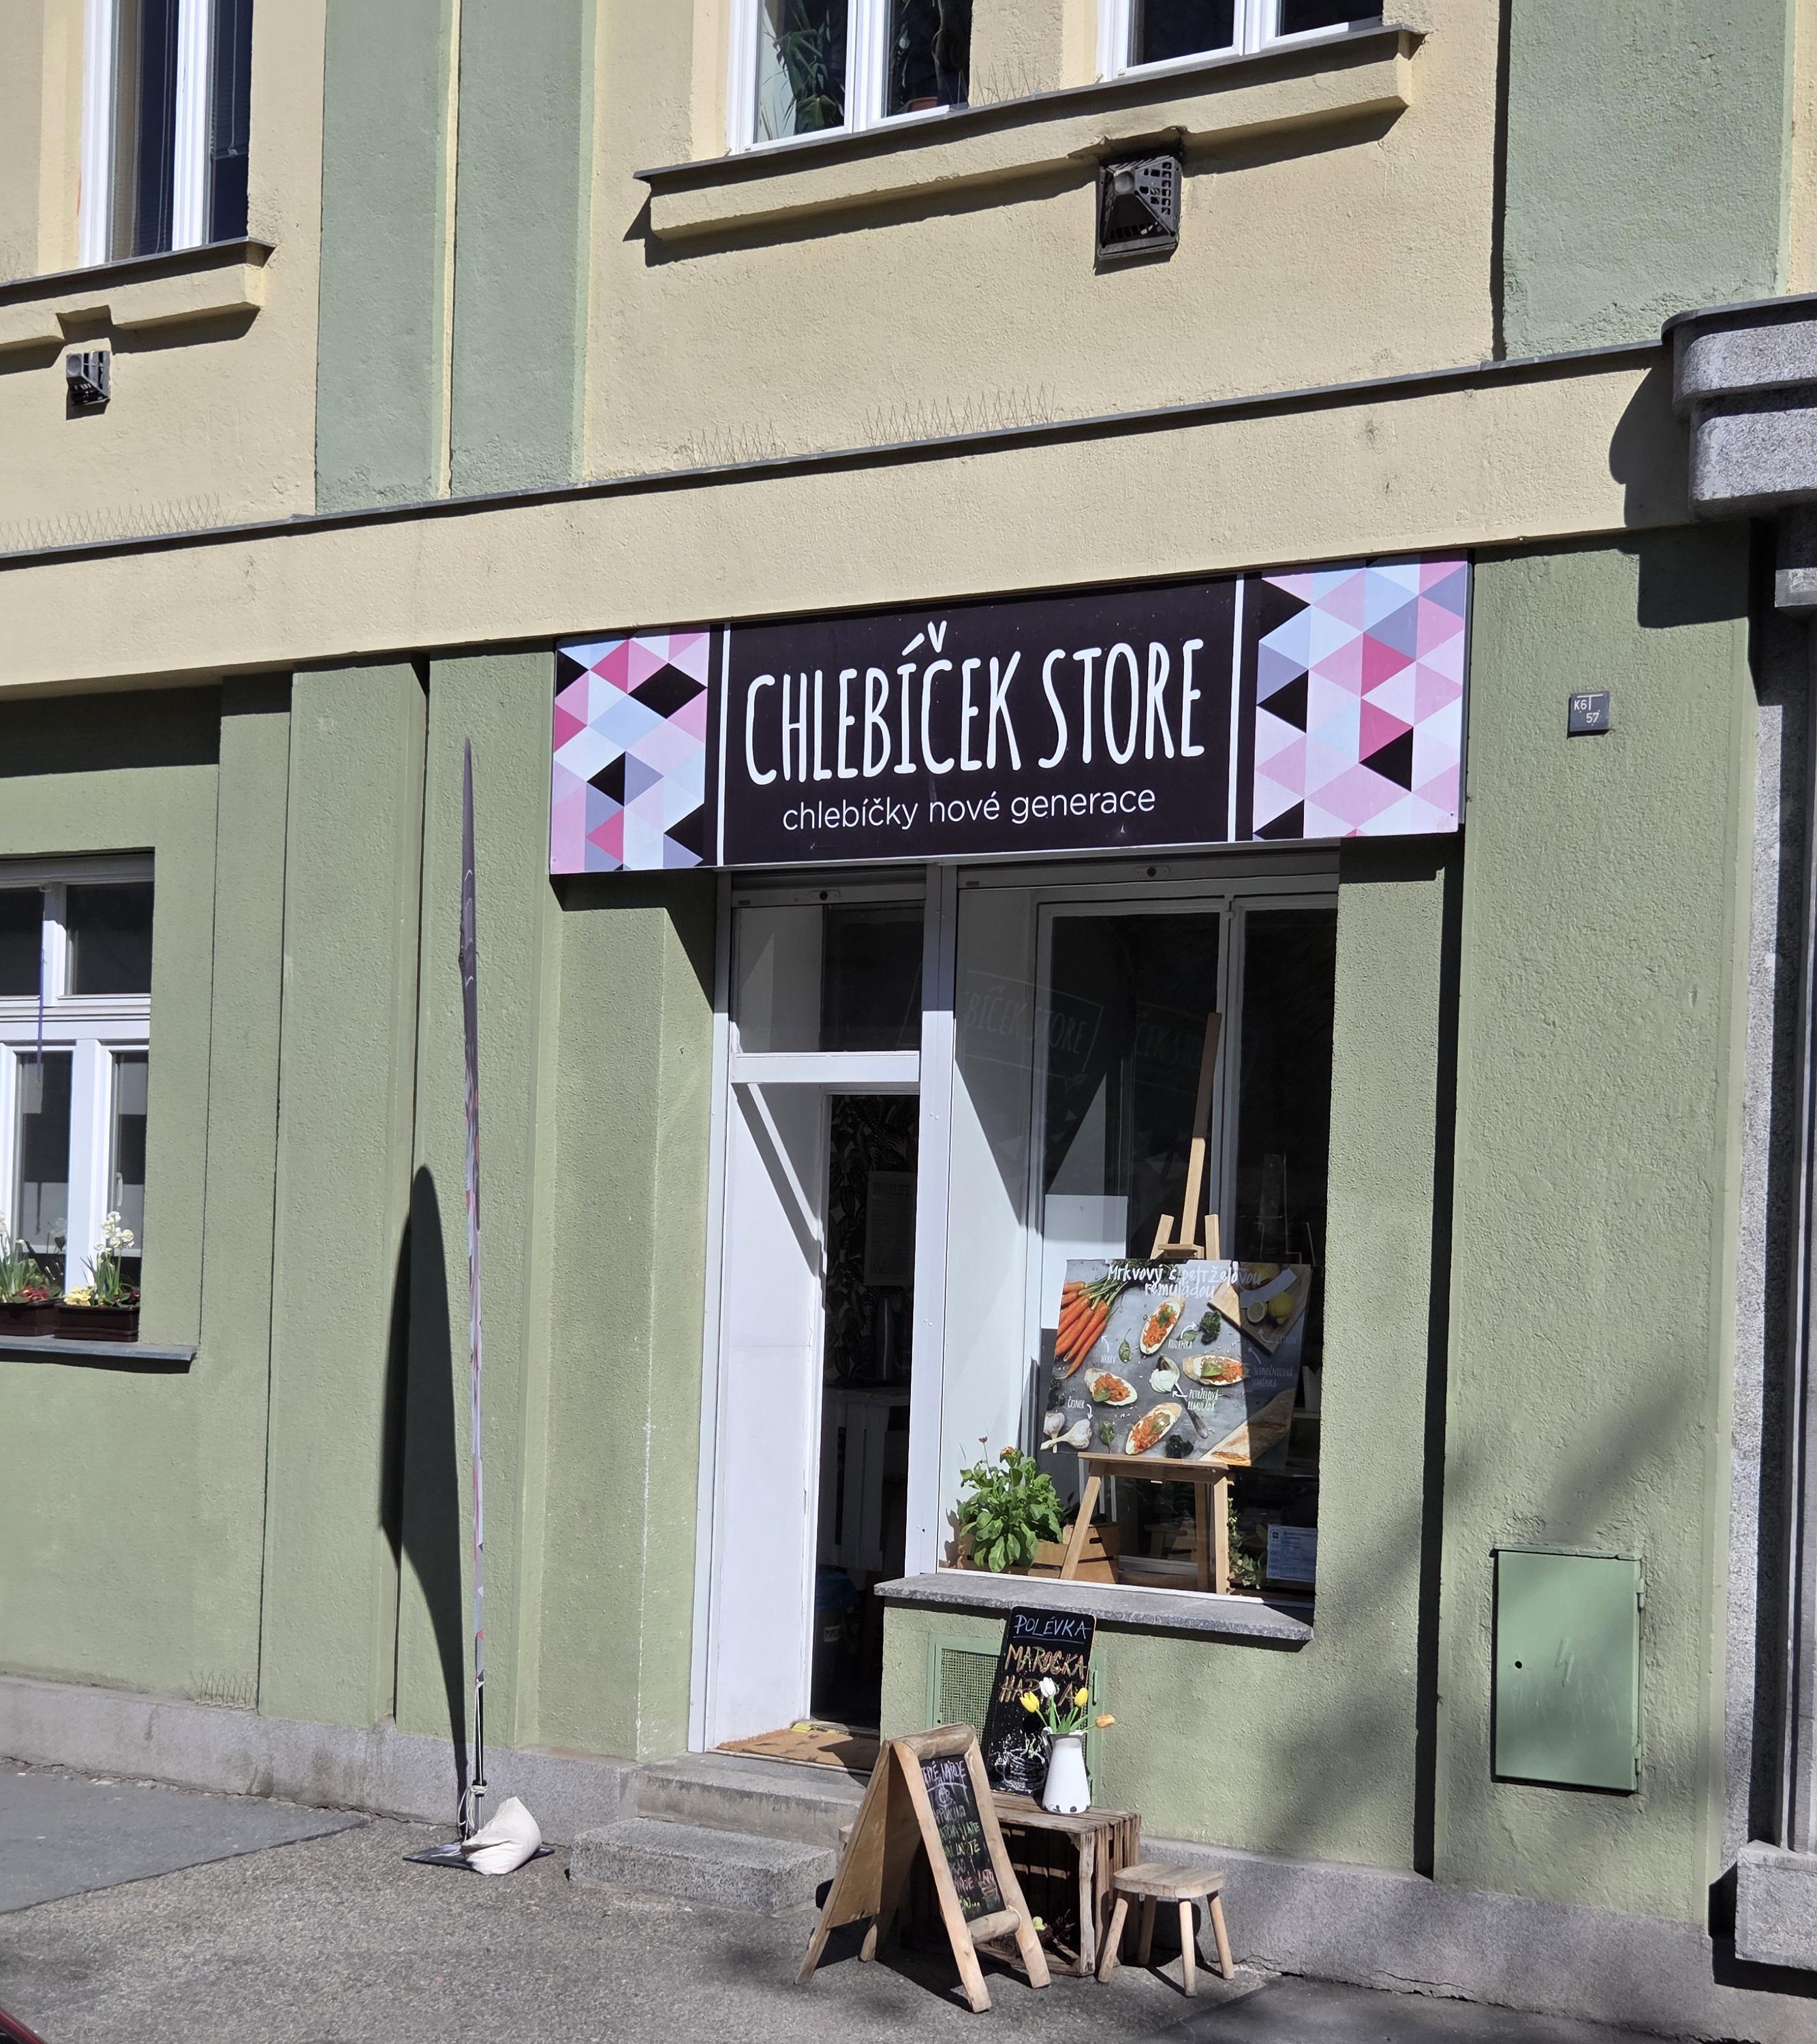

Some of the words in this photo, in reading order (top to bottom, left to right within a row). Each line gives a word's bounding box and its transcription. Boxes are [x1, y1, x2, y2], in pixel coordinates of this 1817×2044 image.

[745, 620, 1021, 786] CHLEBÍČEK
[1038, 638, 1205, 769] STORE
[1586, 712, 1600, 723] 57
[782, 797, 919, 831] chlebíčky
[929, 791, 999, 823] nové
[1010, 788, 1156, 824] generace
[1107, 1263, 1163, 1285] Mrkvový
[1180, 1265, 1262, 1286] petrželovou
[1014, 1614, 1091, 1639] POLÉVKA
